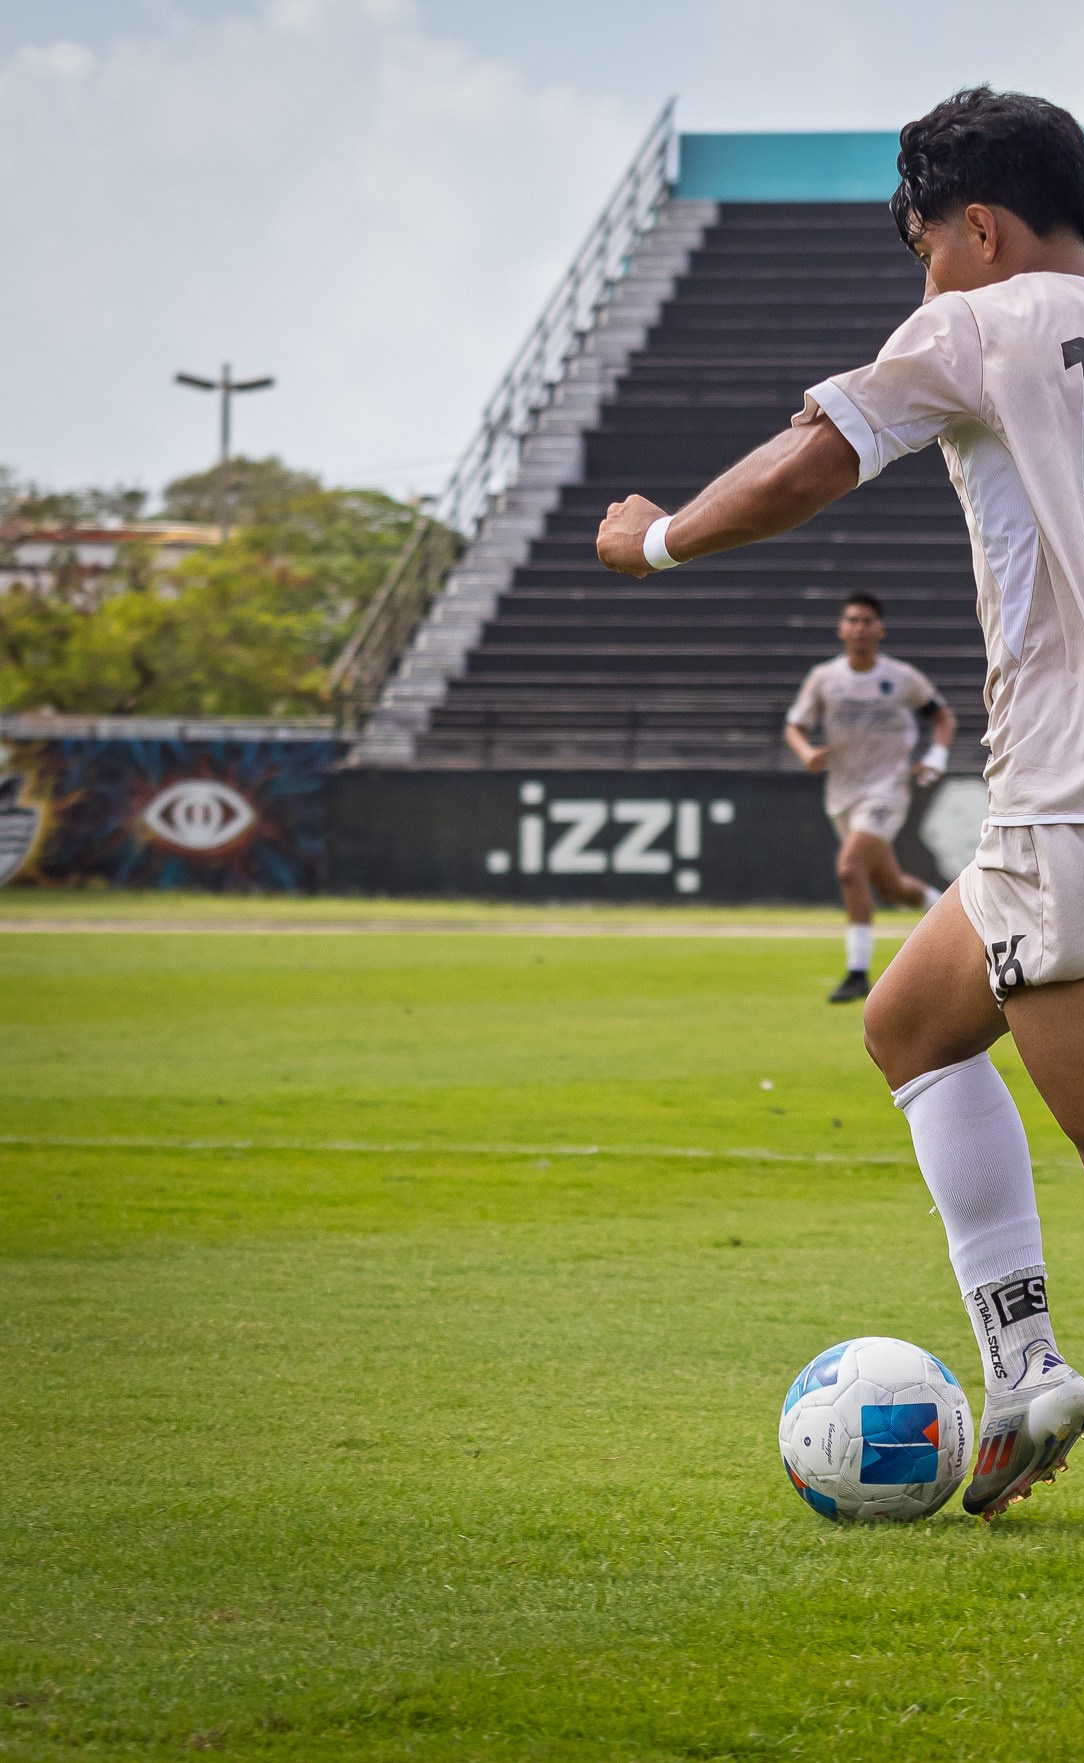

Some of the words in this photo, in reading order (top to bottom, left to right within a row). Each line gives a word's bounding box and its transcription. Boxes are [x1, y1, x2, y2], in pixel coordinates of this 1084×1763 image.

[988, 1335, 1008, 1379] SOCKS
[824, 1422, 836, 1466] Vantaggio
[955, 1410, 966, 1469] molten
